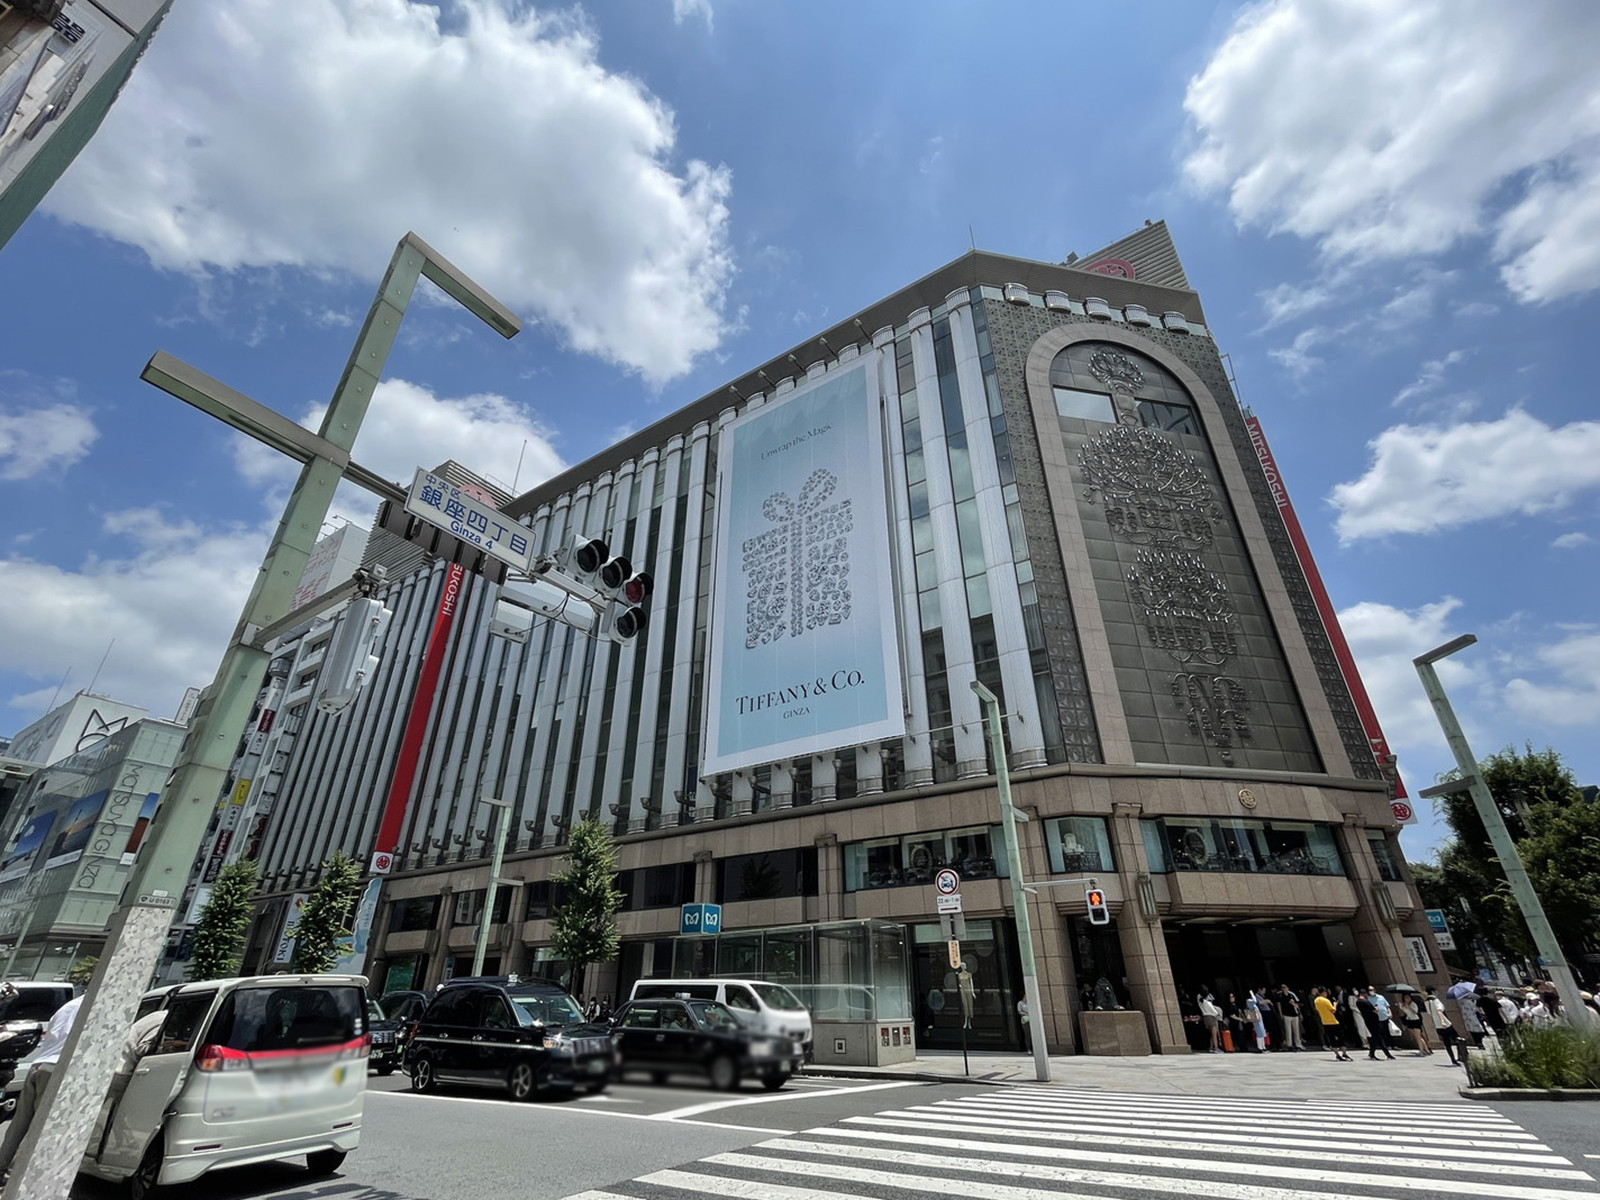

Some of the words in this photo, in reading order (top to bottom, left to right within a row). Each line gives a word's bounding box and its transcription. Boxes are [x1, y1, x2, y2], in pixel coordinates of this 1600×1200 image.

[1247, 423, 1288, 508] MITSUKOSHI
[425, 473, 461, 500] 中央区
[419, 485, 527, 556] 銀座四丁目
[450, 520, 481, 544] Ginza
[485, 540, 494, 550] 4
[735, 682, 811, 715] TIFFANY
[813, 677, 827, 696] &
[783, 706, 811, 719] GINZA
